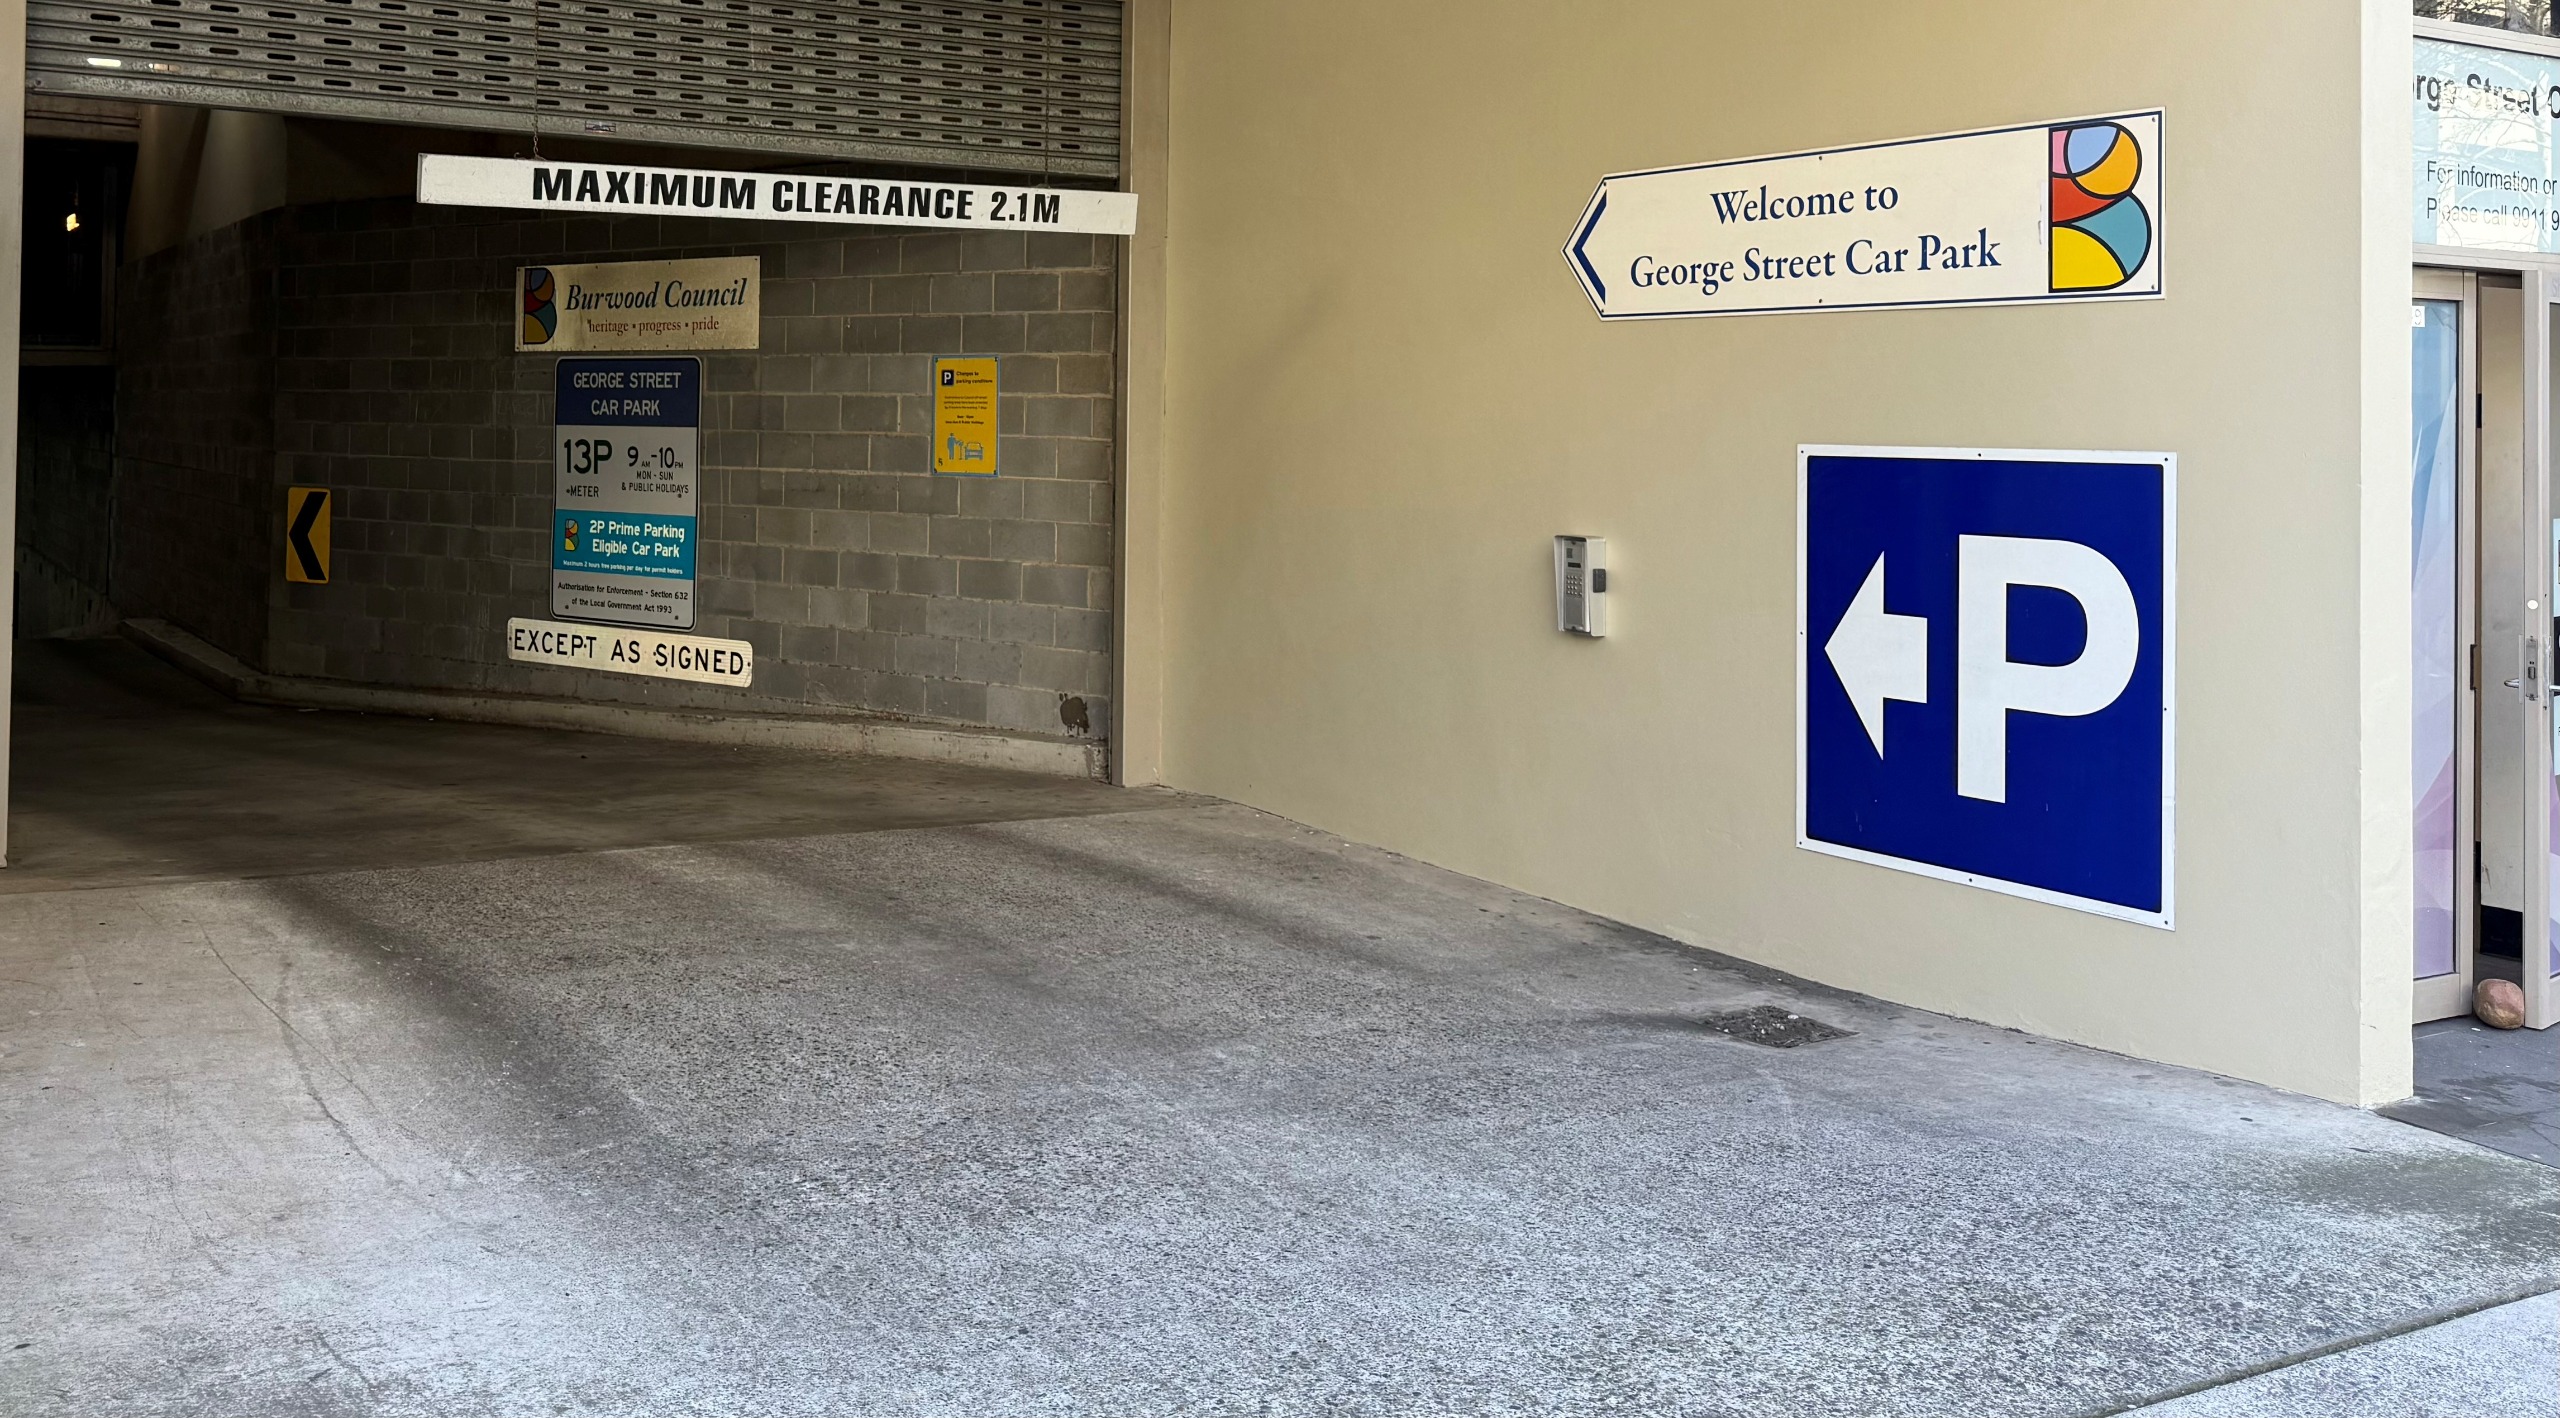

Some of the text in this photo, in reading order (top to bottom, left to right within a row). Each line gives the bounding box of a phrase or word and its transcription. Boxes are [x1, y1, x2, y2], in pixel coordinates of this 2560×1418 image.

[2427, 160, 2558, 196] For information or
[532, 166, 1061, 223] MAXIMUM CLEARANCE 2.1M
[1709, 184, 1899, 225] Welcome to
[2427, 197, 2478, 223] Please
[2483, 204, 2507, 226] call
[2512, 205, 2545, 231] 9911
[1630, 227, 2002, 296] George Street Car Park
[565, 277, 748, 311] Burwood Council
[589, 315, 720, 337] heritage progress pride
[573, 372, 682, 389] GEORGE STREET
[943, 371, 952, 384] P
[591, 399, 661, 417] CAR PARK
[563, 438, 613, 475] 13P
[636, 470, 652, 480] MON
[659, 471, 674, 481] SUN
[570, 485, 599, 498] METER
[621, 482, 689, 495] & PUBLIC HOLIDAYS
[589, 519, 685, 543] 2P Prime Parking
[592, 538, 680, 558] Eligible Car Park
[557, 582, 595, 593] Authorisation
[596, 585, 605, 593] for
[606, 585, 643, 596] Enforcement
[650, 589, 673, 599] Section
[674, 591, 688, 600] 632
[571, 597, 672, 614] of the Local Government Act 1993
[513, 628, 744, 676] EXCEPT AS SIGNED
[1957, 533, 2140, 804] P
